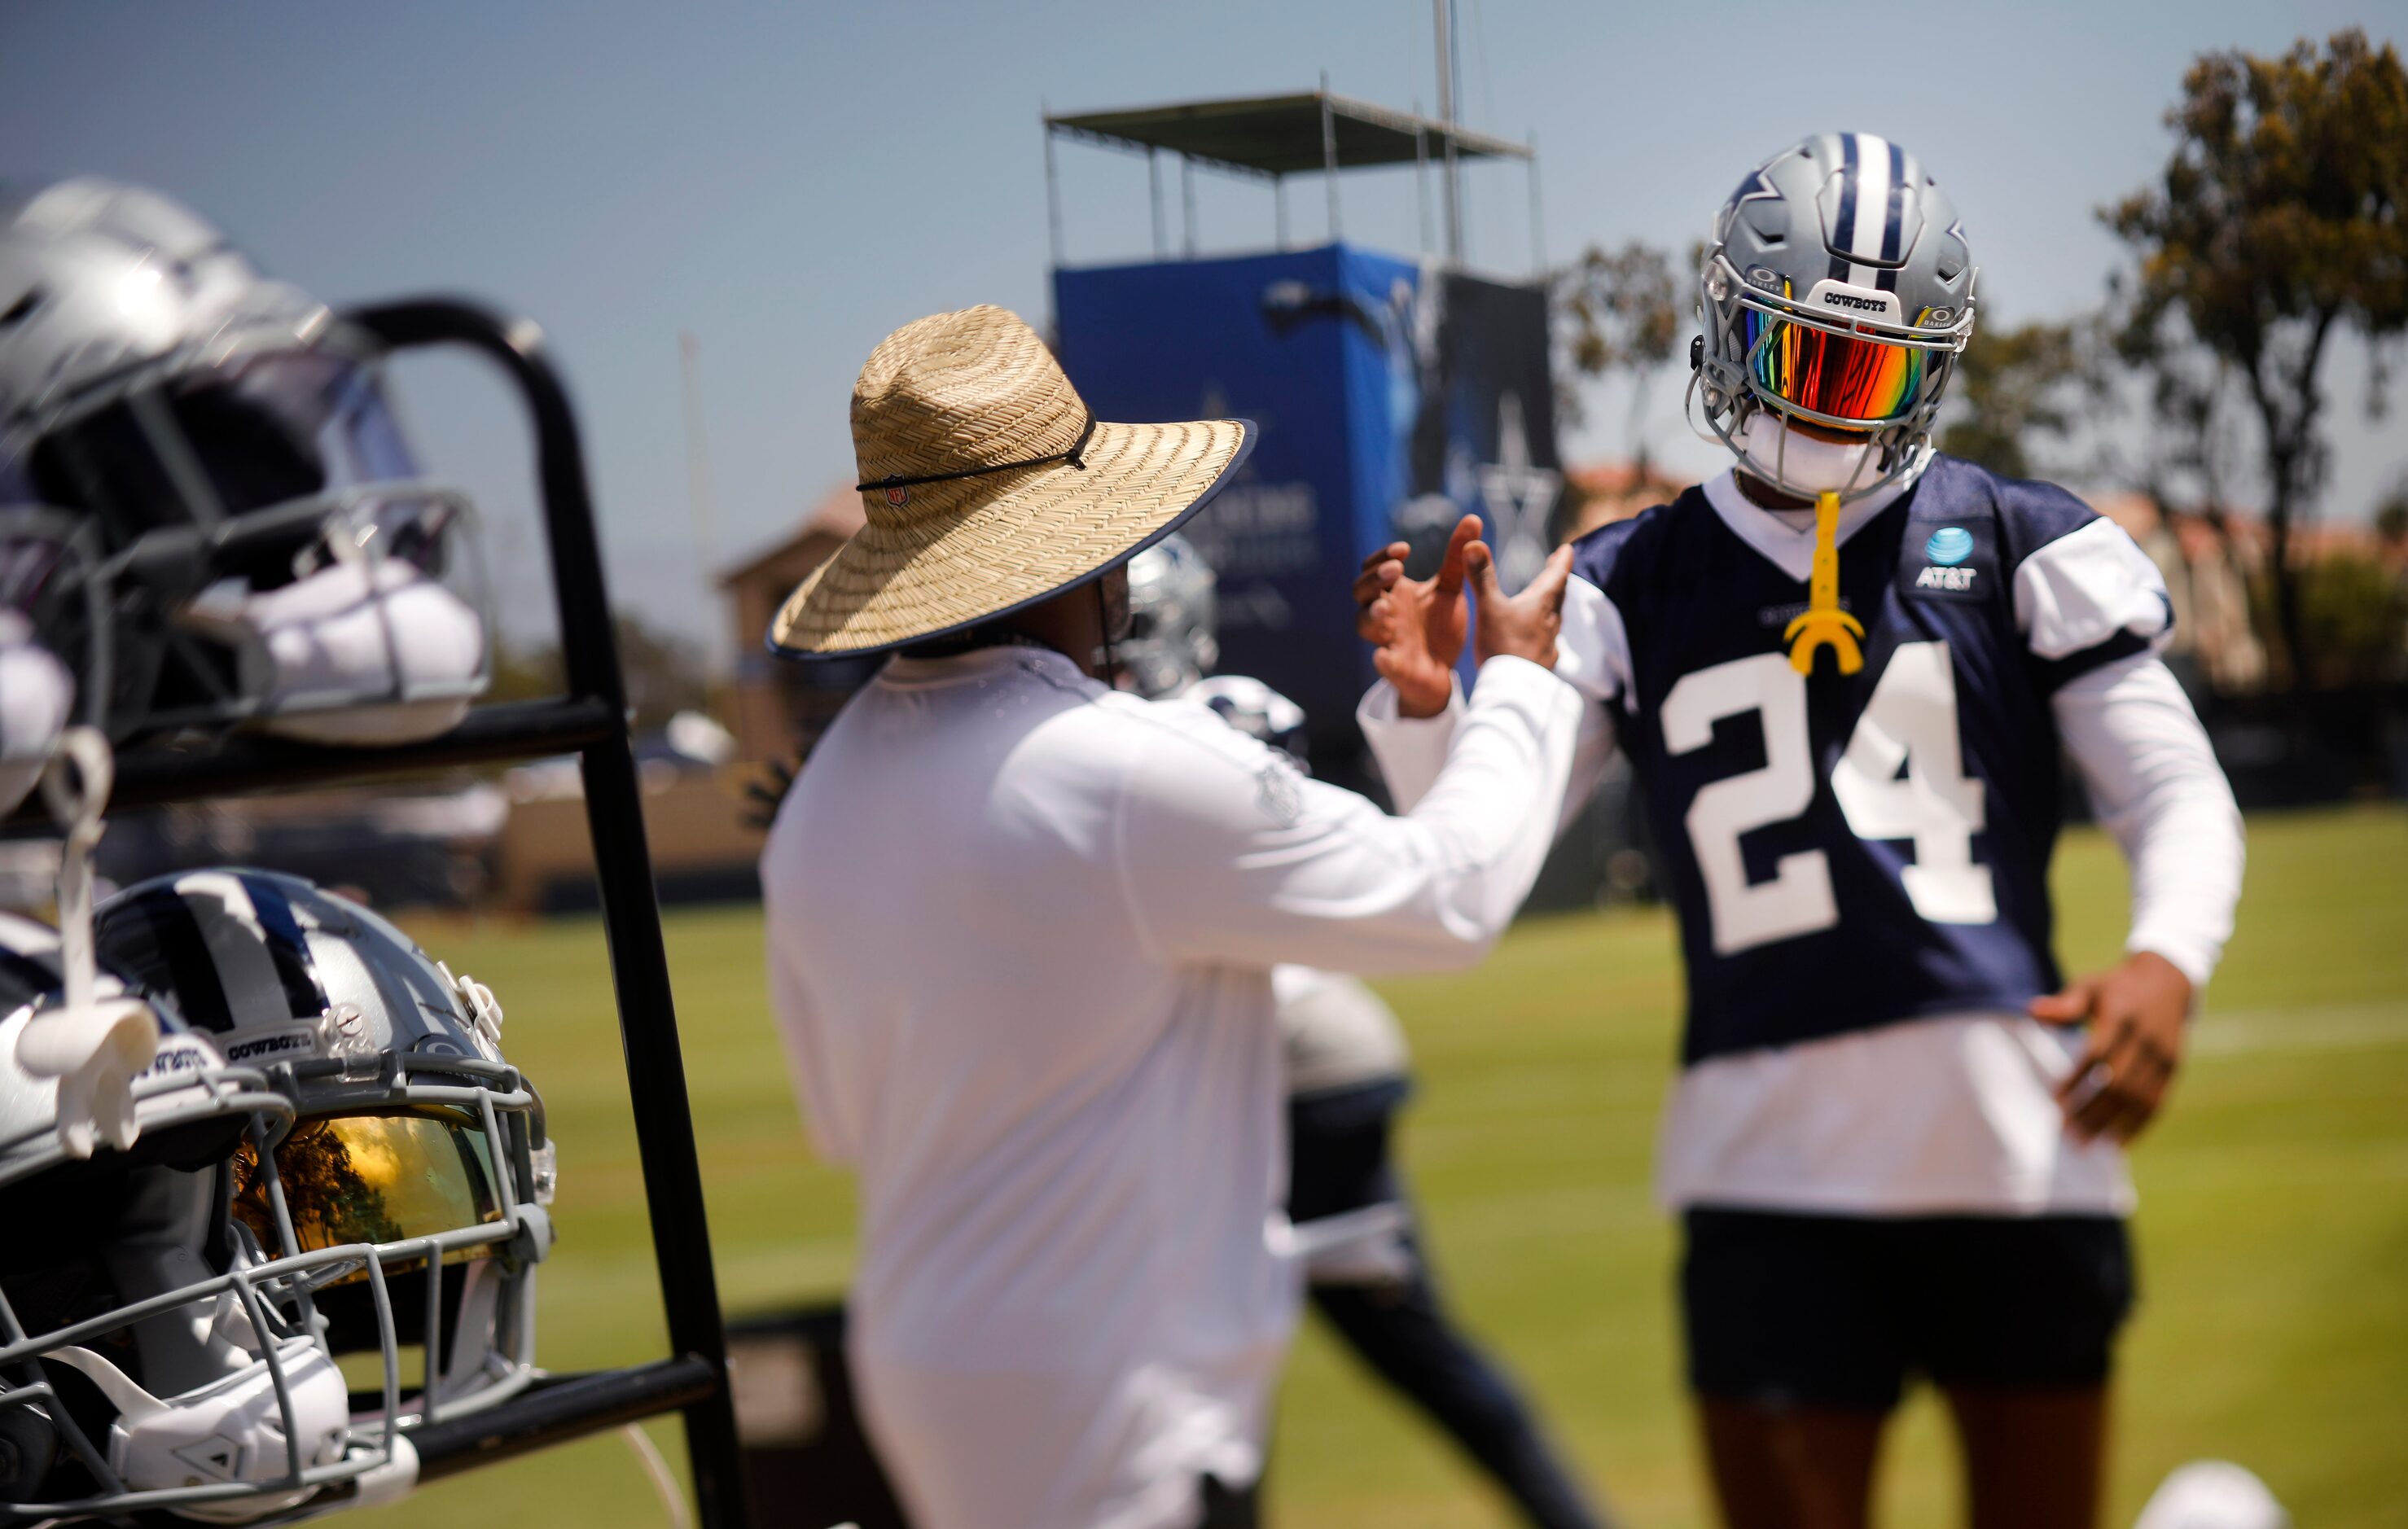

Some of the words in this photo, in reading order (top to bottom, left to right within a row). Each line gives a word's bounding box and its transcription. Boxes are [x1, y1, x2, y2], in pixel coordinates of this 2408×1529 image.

[1747, 278, 1782, 291] OAKLEY
[1824, 291, 1887, 313] COWBOYS
[888, 488, 906, 502] NFL
[1915, 566, 1977, 591] AT&T
[1660, 640, 1998, 956] 24
[228, 1033, 312, 1061] COWBOYS
